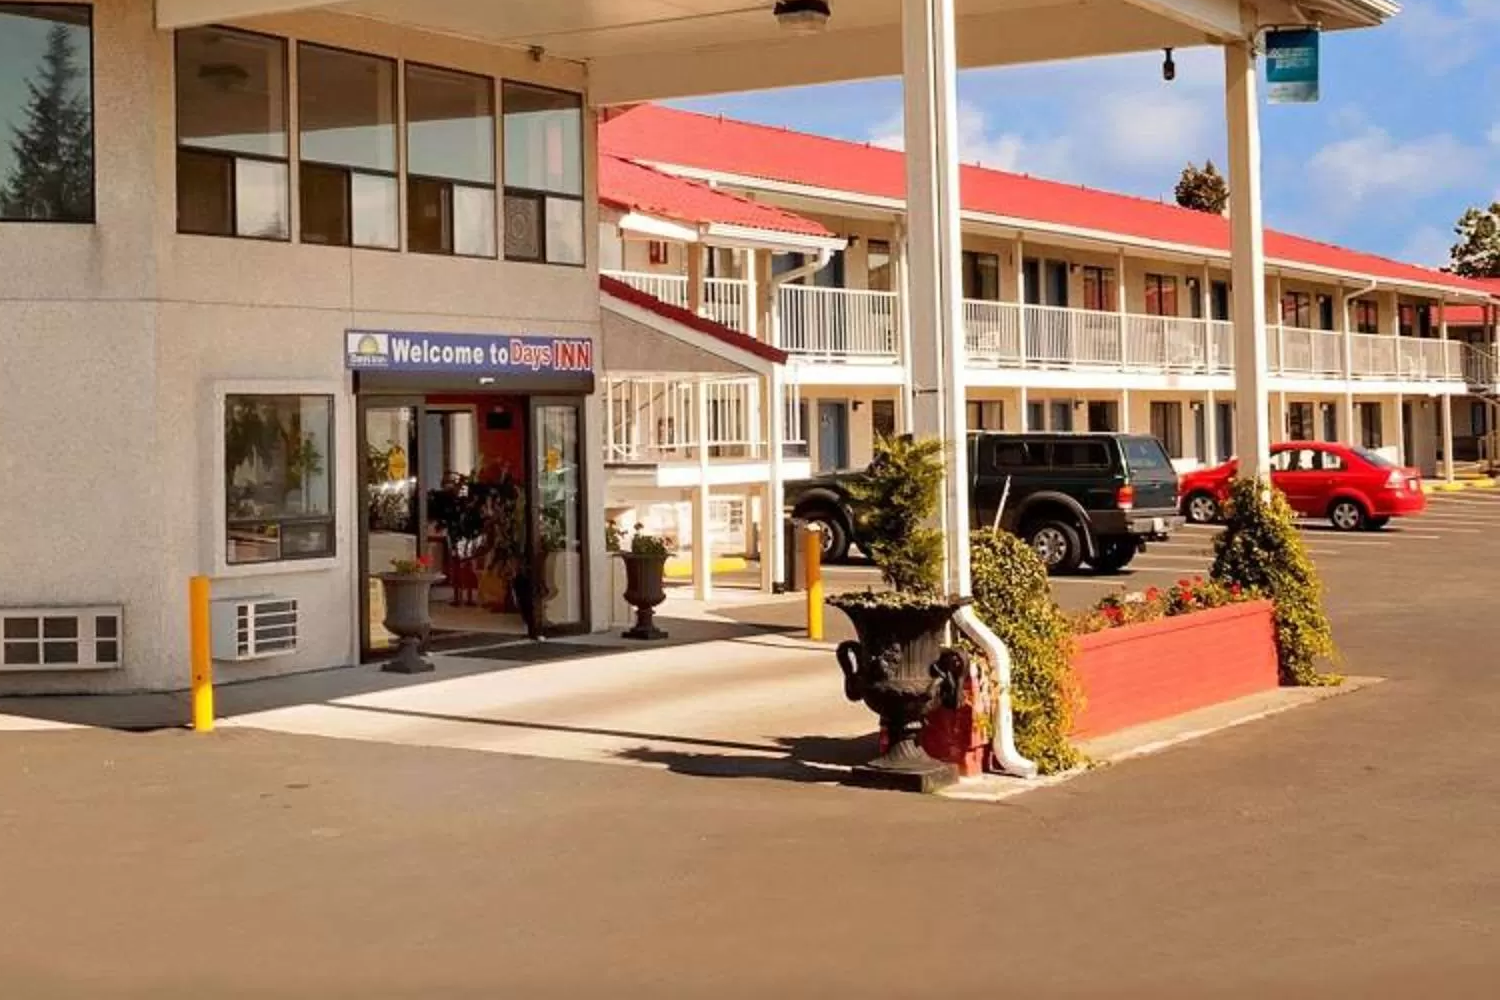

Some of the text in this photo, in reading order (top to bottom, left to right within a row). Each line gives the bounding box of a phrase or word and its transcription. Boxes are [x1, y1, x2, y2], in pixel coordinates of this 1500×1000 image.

[392, 338, 484, 364] Welcome
[490, 343, 508, 365] to
[509, 338, 551, 370] Days
[553, 340, 591, 370] INN
